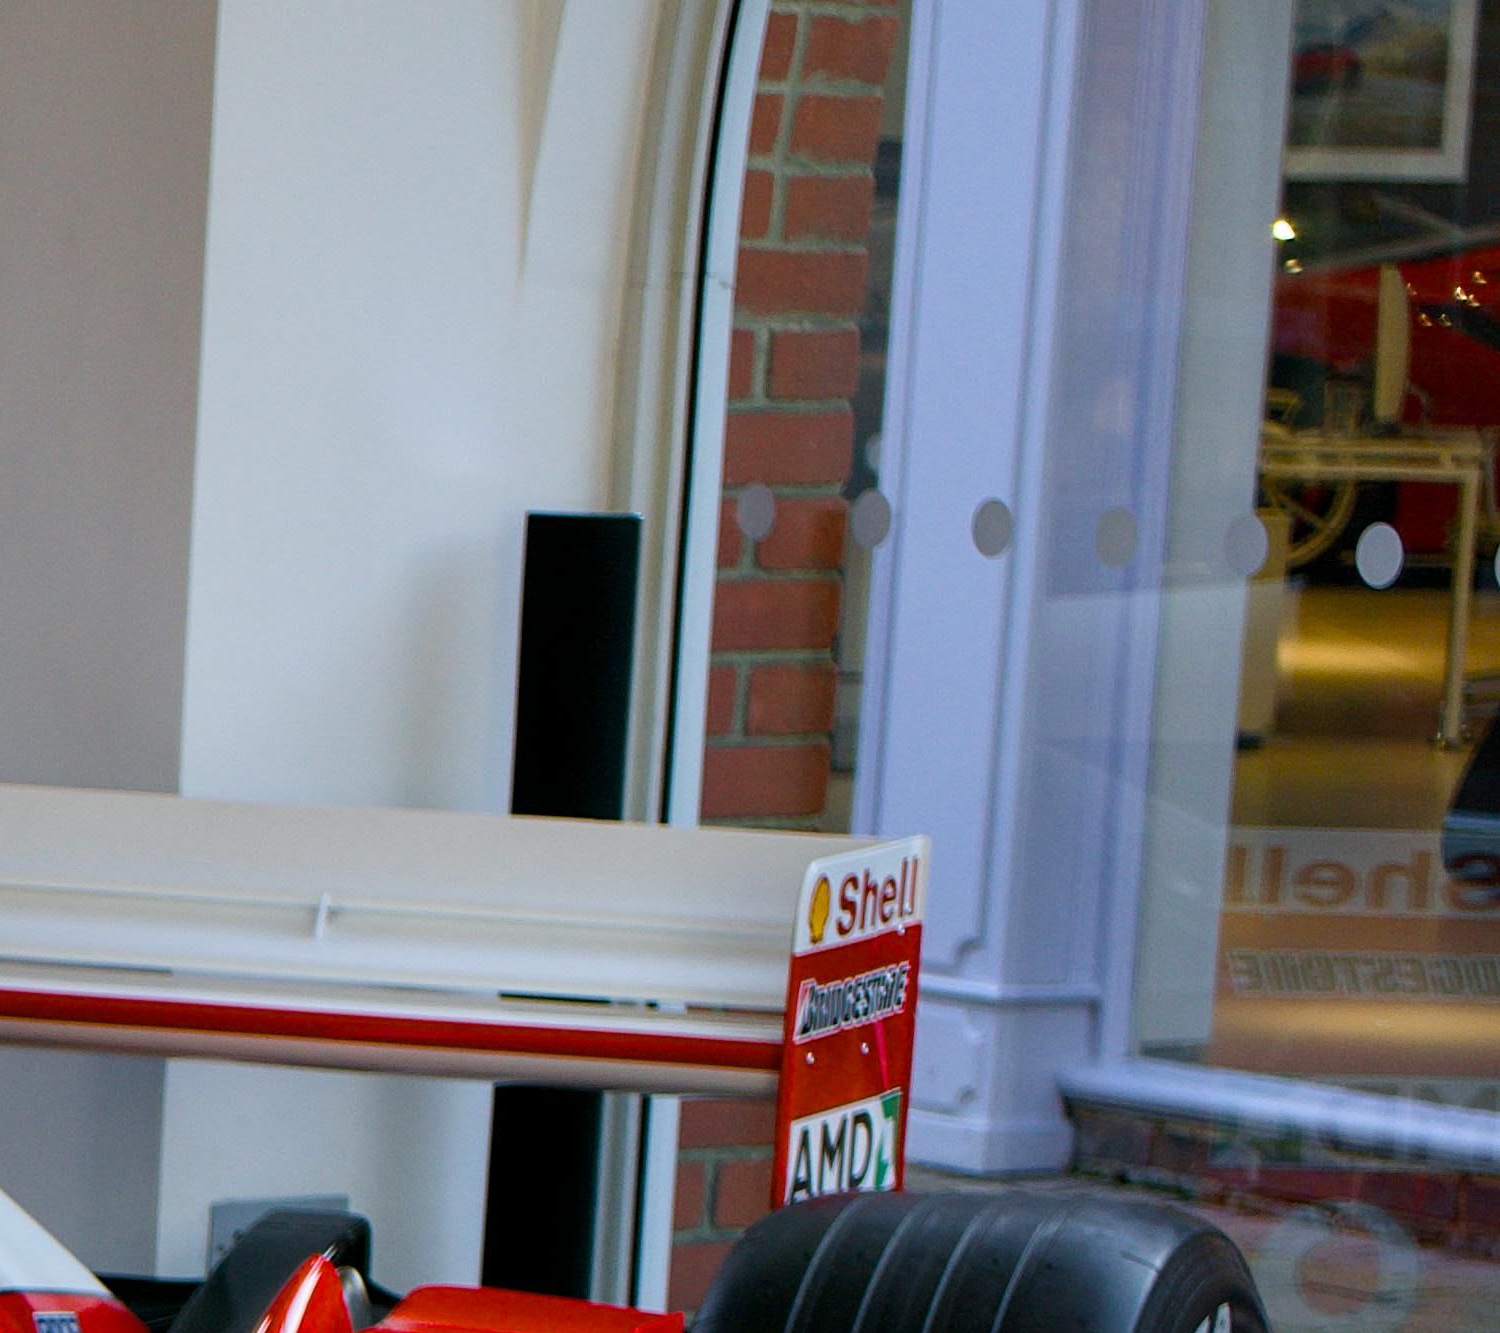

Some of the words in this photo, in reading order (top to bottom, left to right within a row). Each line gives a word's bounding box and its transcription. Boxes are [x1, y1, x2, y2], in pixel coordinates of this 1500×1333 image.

[837, 856, 918, 936] Shell
[796, 962, 909, 1042] BRIDGESTONE
[790, 1109, 872, 1203] AMD
